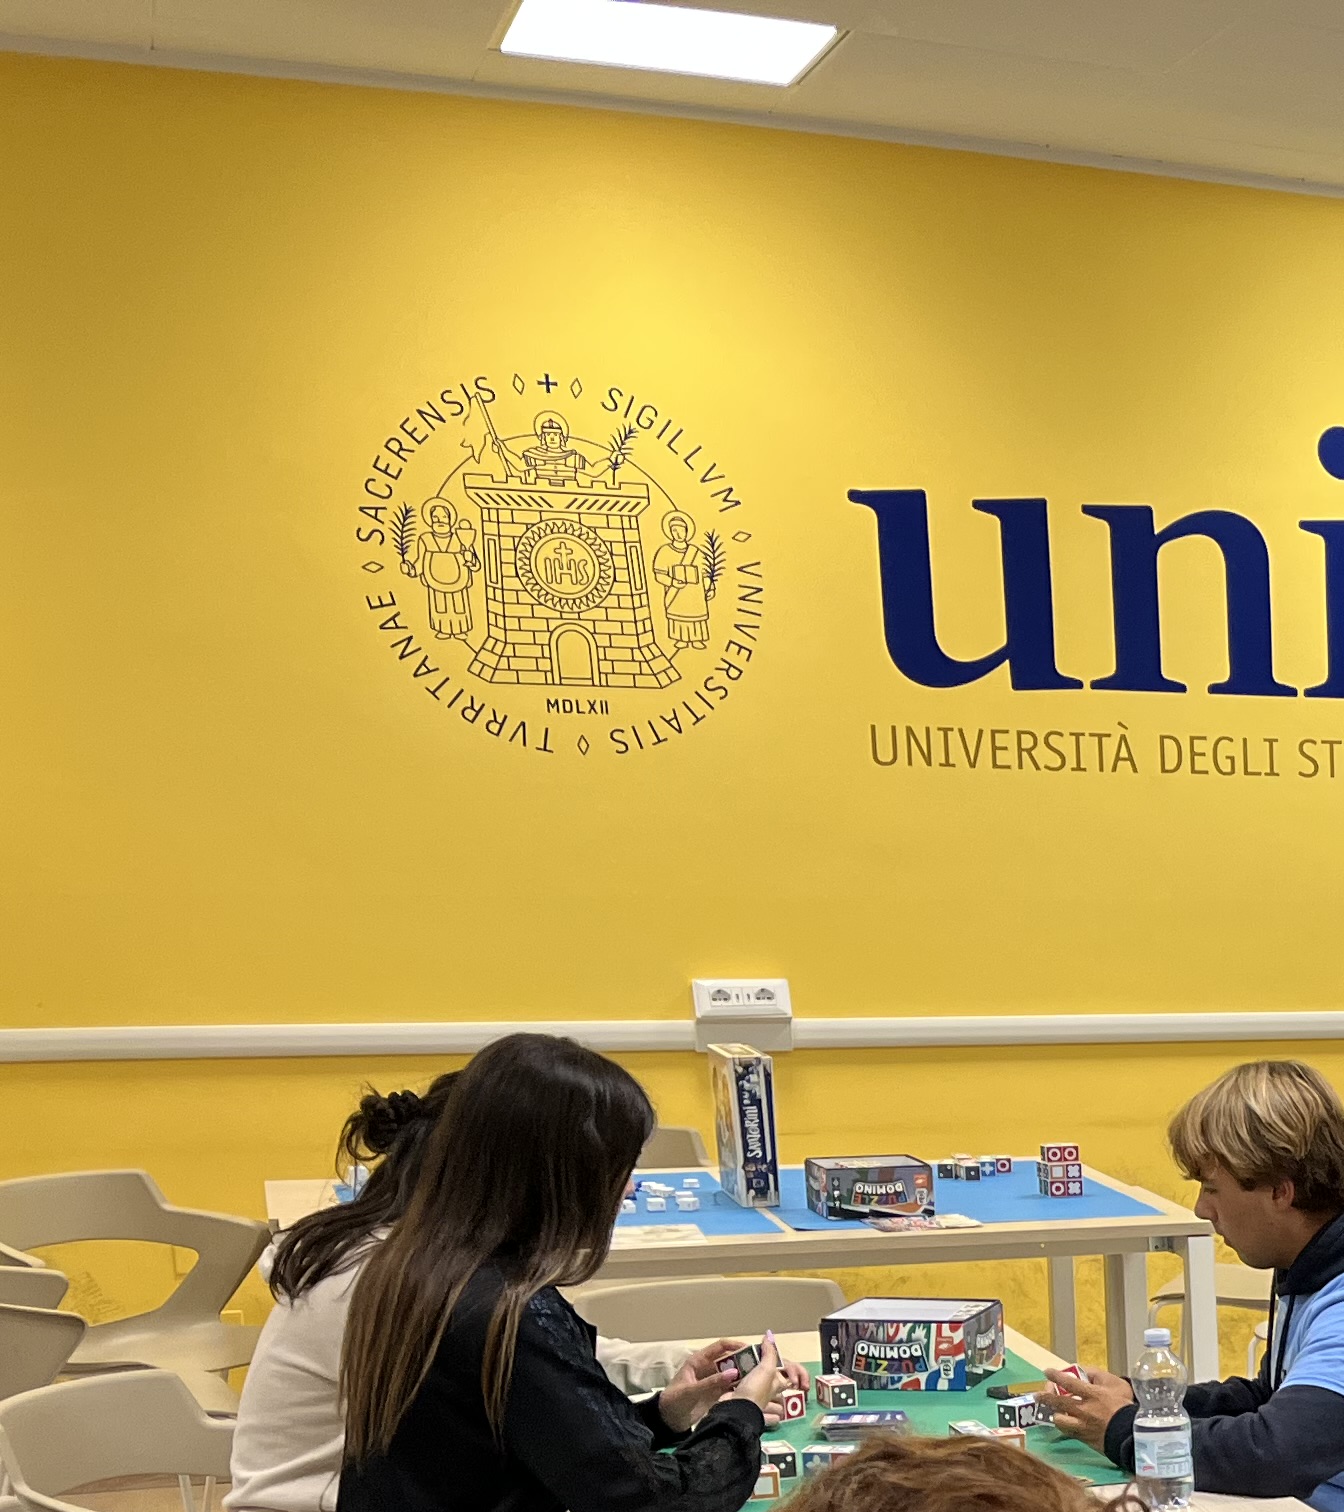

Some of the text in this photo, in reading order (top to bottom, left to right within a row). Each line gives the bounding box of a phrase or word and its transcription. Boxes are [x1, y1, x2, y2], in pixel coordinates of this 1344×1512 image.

[355, 375, 763, 754] SIGILLVM VNIVERSITATIS TVRRITANAE SACERENSIS
[546, 697, 610, 715] MDLXII
[869, 721, 1138, 775] UNIVERSITÀ
[1157, 734, 1281, 778] DEGLI
[855, 1182, 904, 1195] DOMINO
[854, 1194, 908, 1206] PUZZLE
[857, 1342, 923, 1359] DOMINO
[855, 1355, 929, 1374] PUZZLE
